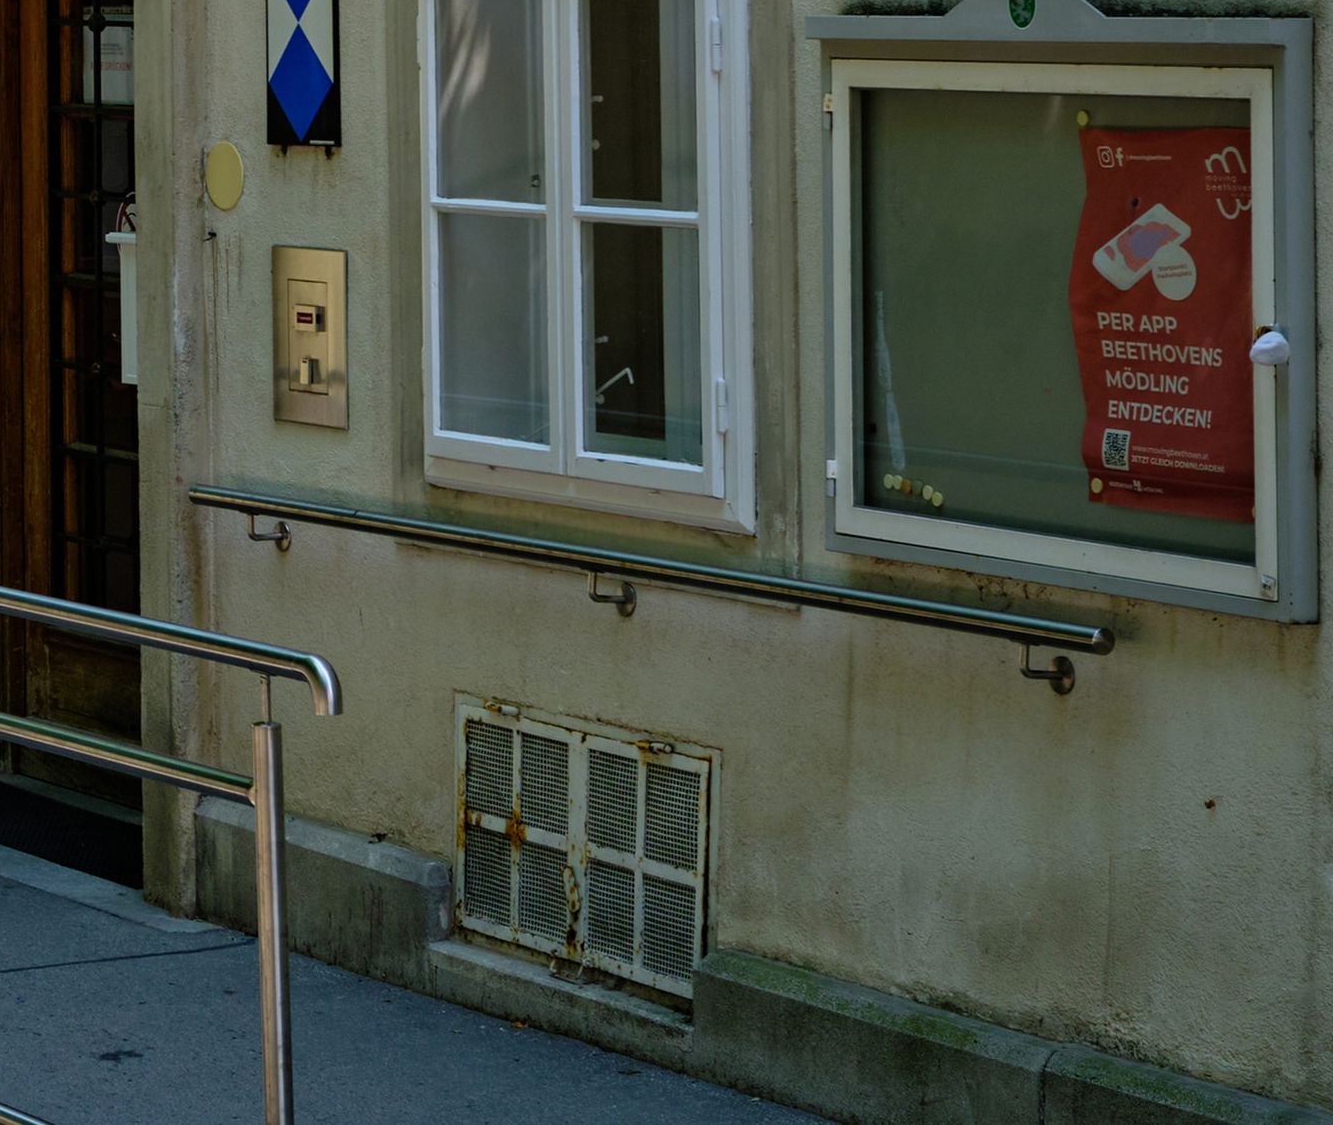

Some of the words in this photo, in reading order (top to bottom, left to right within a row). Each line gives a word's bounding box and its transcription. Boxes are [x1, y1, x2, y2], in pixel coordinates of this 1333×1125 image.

[1097, 311, 1135, 332] PER
[1139, 315, 1178, 334] APP
[1101, 339, 1223, 367] BEETHOVENS
[1105, 367, 1189, 395] MÖDLING
[1108, 400, 1212, 429] ENTDECKEN!
[1131, 454, 1149, 464] JETZT
[1150, 457, 1174, 468] GLEICH
[1174, 460, 1225, 473] DOWNLOADEN!
